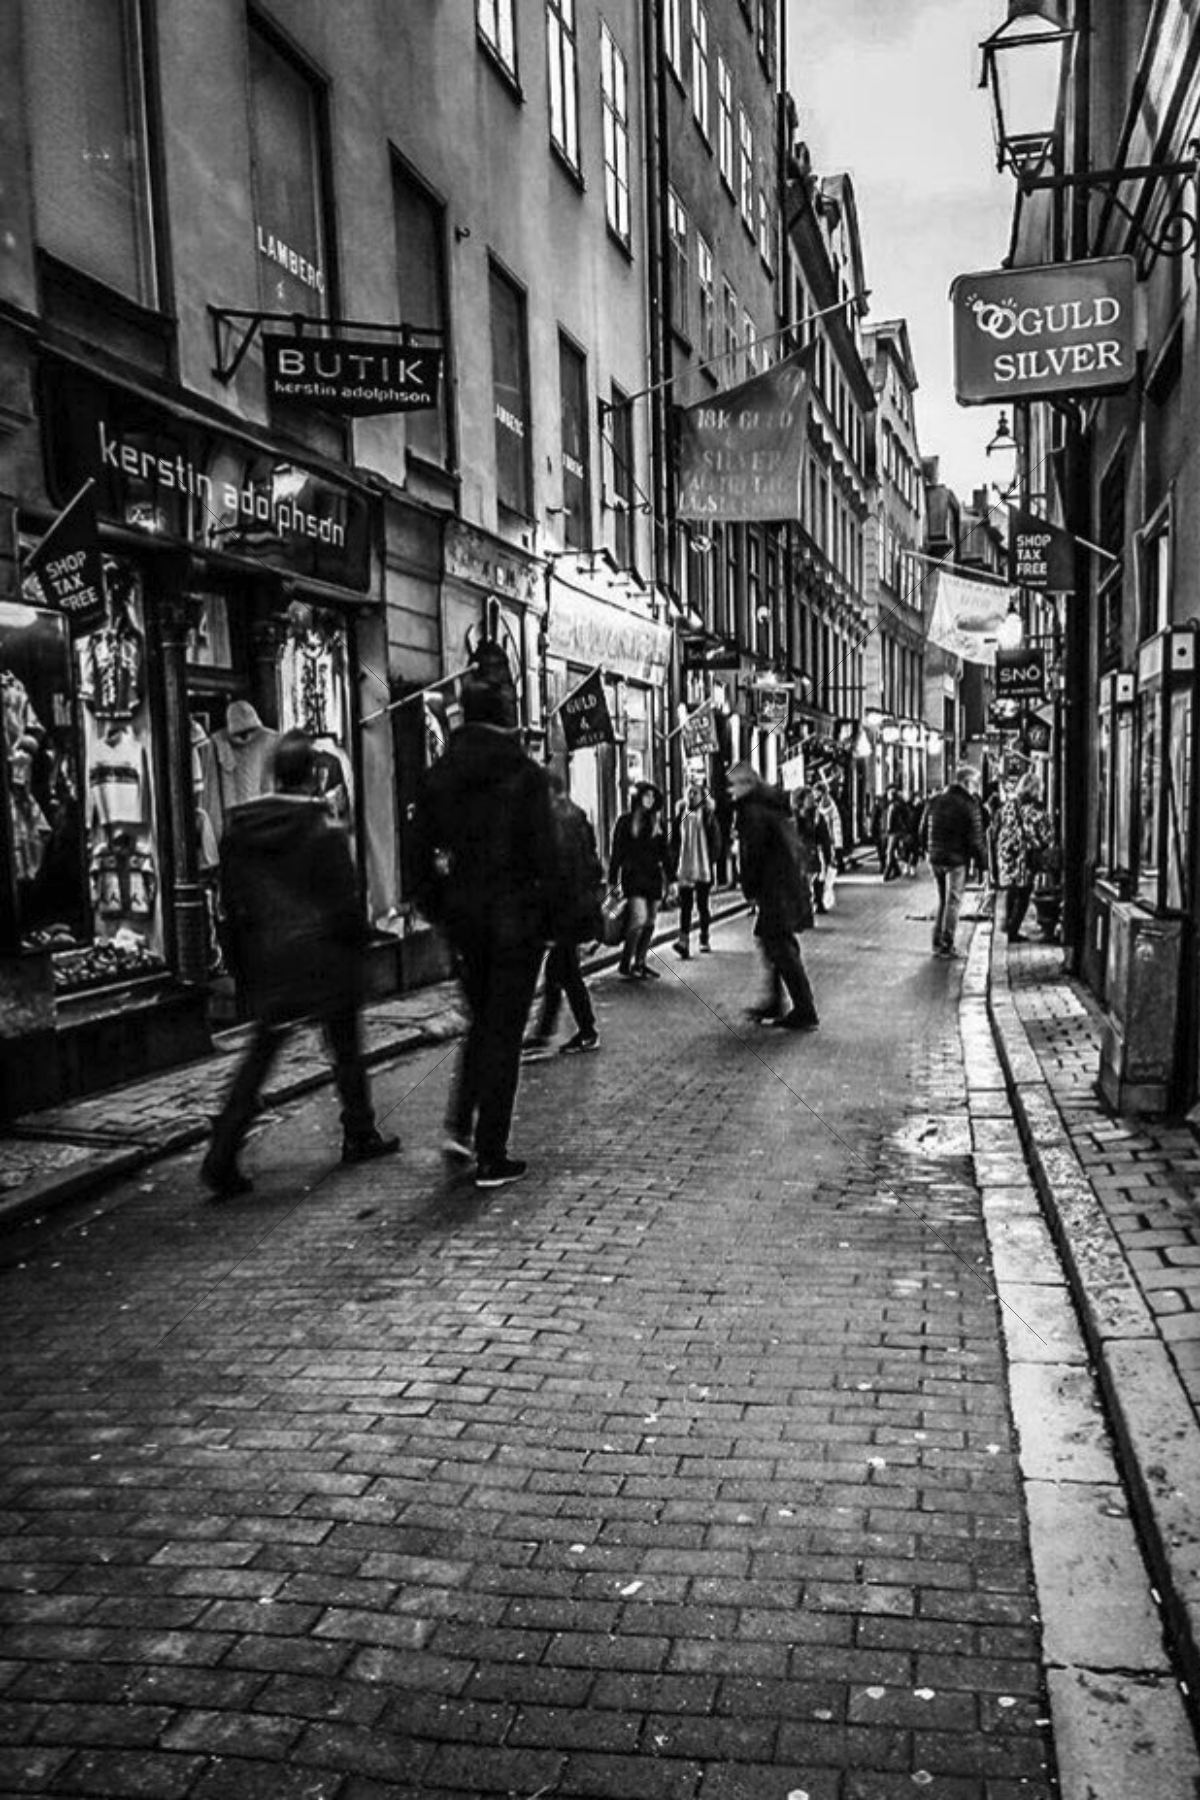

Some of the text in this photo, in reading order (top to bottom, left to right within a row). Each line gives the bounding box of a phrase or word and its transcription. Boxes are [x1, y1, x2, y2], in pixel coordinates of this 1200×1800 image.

[1017, 296, 1121, 336] GULD
[278, 349, 424, 384] BUTIK
[993, 340, 1123, 382] SILVER
[274, 379, 431, 403] kerstin adolphson
[98, 420, 344, 547] kerstin adolphson
[1016, 533, 1052, 548] SHOP
[45, 550, 87, 580] SHOP
[1016, 549, 1042, 560] TAX
[1015, 562, 1048, 576] FREE
[51, 572, 85, 596] TAX
[59, 585, 99, 611] FREE
